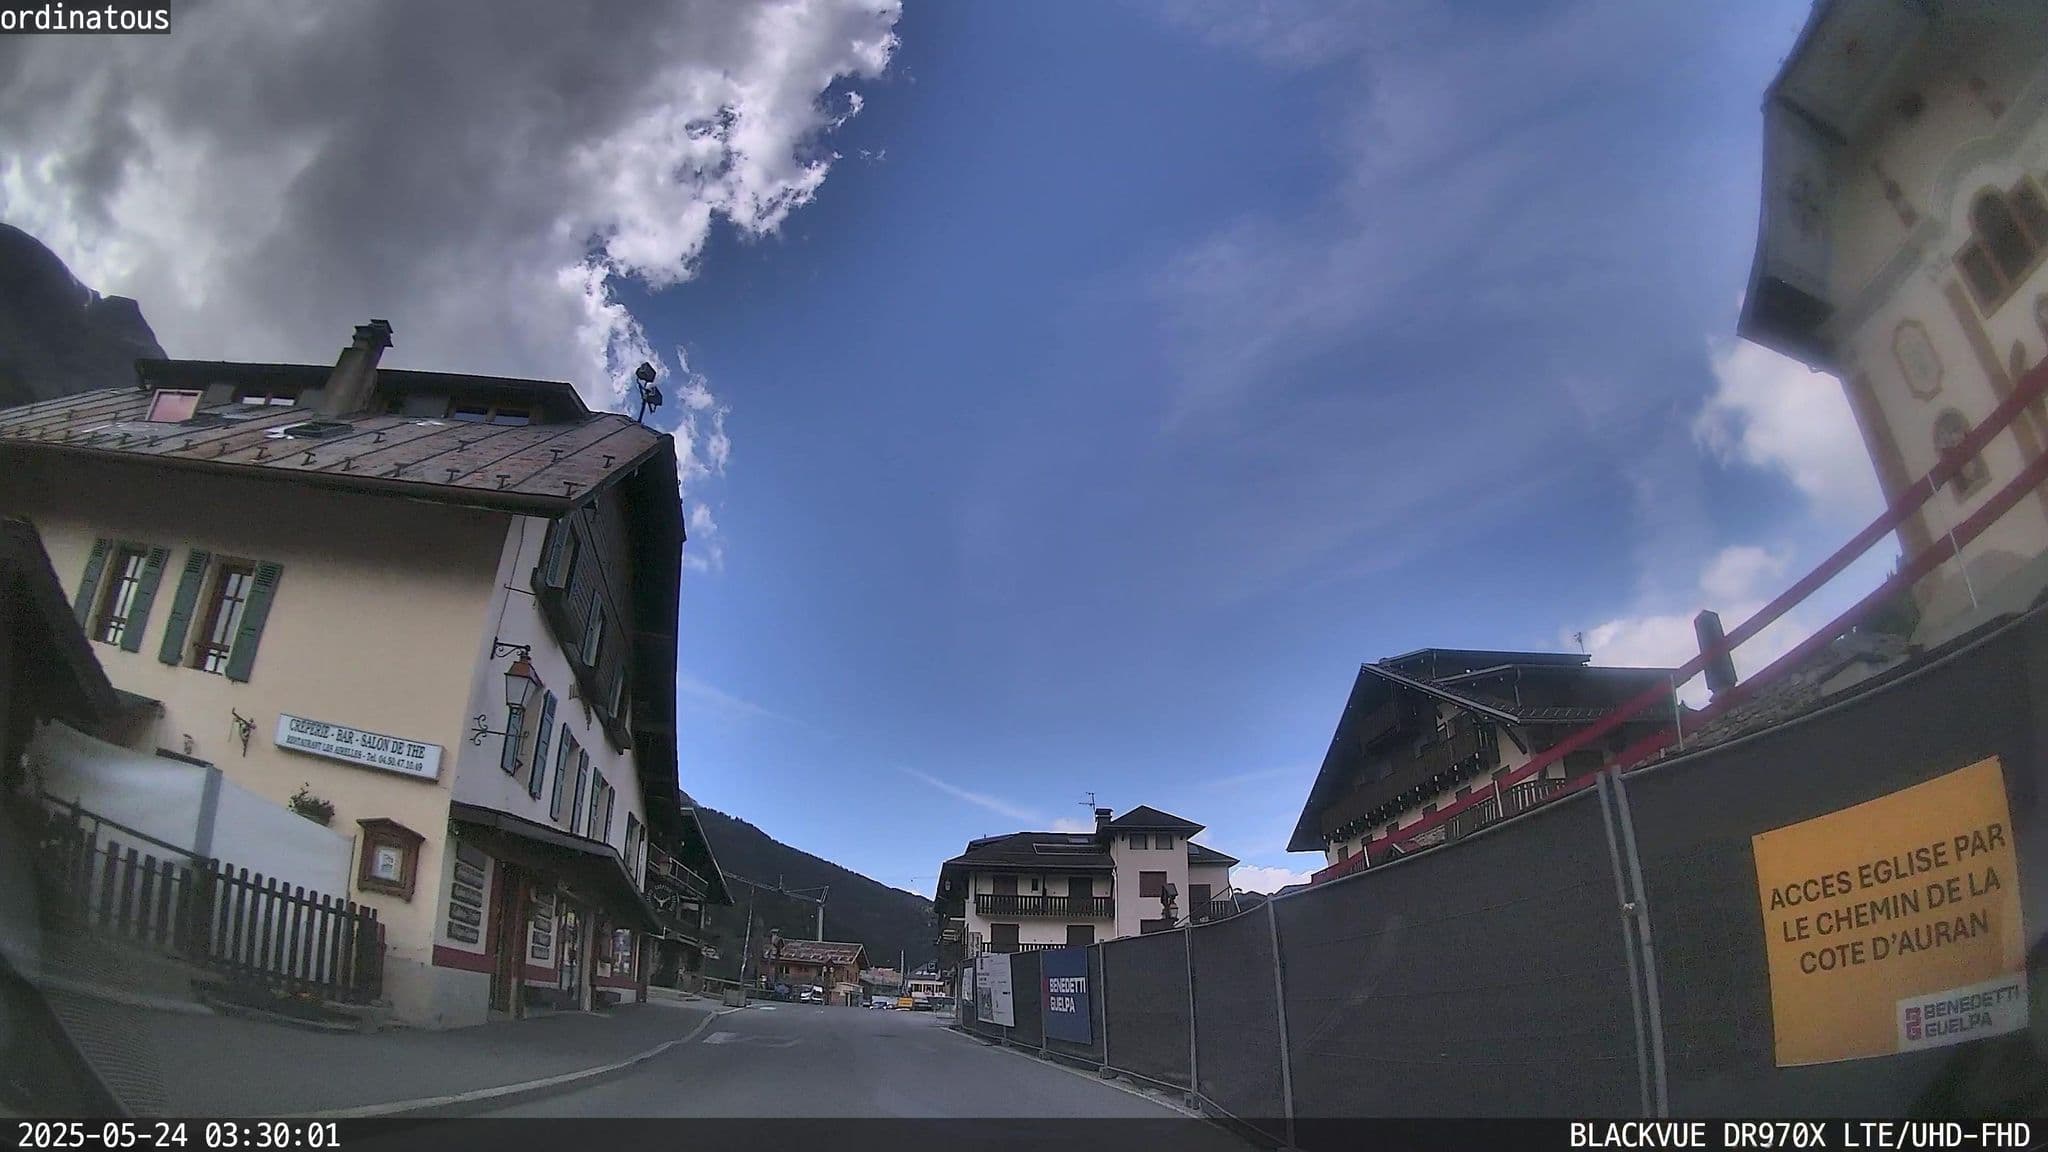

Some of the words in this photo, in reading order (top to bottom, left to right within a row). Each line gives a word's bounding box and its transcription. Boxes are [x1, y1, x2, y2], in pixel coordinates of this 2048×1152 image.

[336, 729, 354, 744] BAR
[361, 734, 390, 752] SALON
[391, 741, 404, 755] DE
[1770, 870, 1852, 911] ACCES
[1858, 842, 1949, 889] EGLISE
[1954, 823, 2006, 861] PAR
[1783, 916, 1810, 942] LE
[1816, 889, 1920, 935] CHEMIN
[1926, 877, 1962, 910] DE
[1968, 866, 2001, 897] LA
[1800, 941, 1866, 975] COTE
[1872, 908, 1989, 962] D'AURAN
[1049, 977, 1086, 994] BENEDETTI
[1050, 996, 1076, 1014] GUELPA
[1924, 984, 2019, 1020] BENEDETTI
[1925, 1012, 1993, 1038] GUELPA
